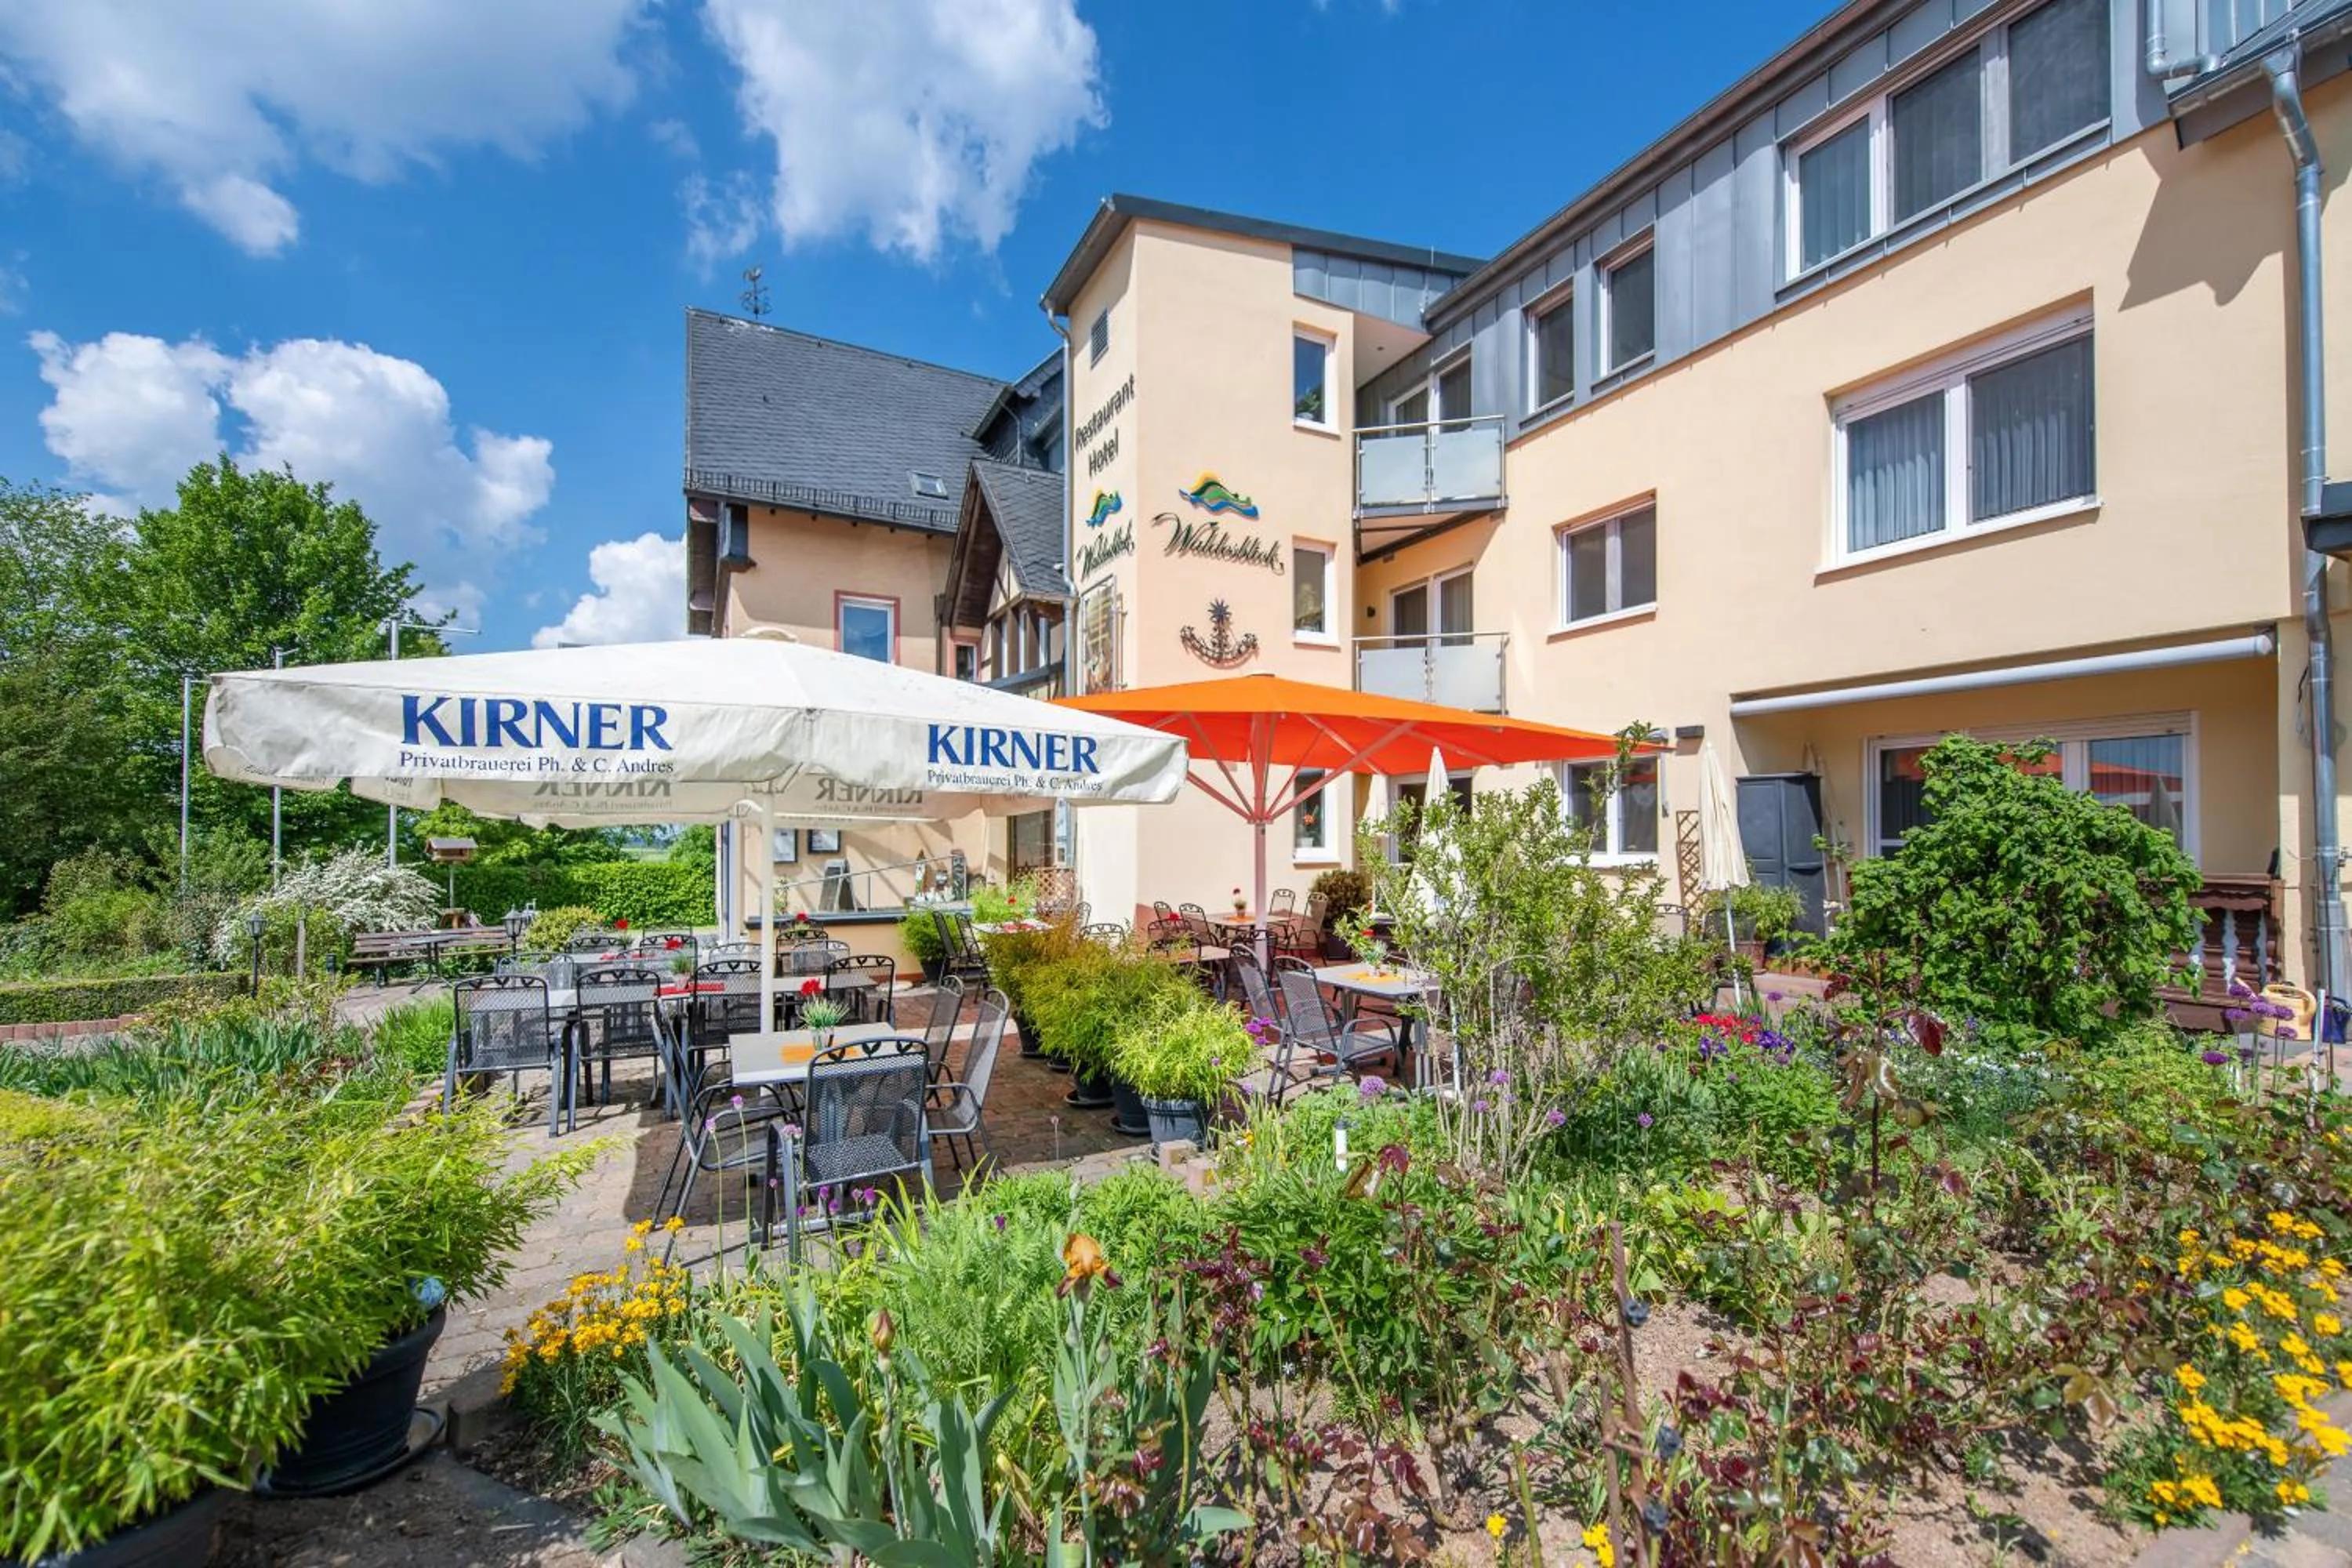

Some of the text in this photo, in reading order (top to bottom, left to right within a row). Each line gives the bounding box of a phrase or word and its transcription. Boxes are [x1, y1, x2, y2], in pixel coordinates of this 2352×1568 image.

[1075, 372, 1134, 453] Restaurant
[1088, 426, 1119, 481] Hotel
[401, 694, 674, 751] KIRNER
[400, 750, 674, 774] Privatbrauerei Ph. & C. Andres
[927, 724, 1101, 775] KIRNER
[927, 769, 1011, 786] Privatbrauerei
[1036, 775, 1045, 789] &
